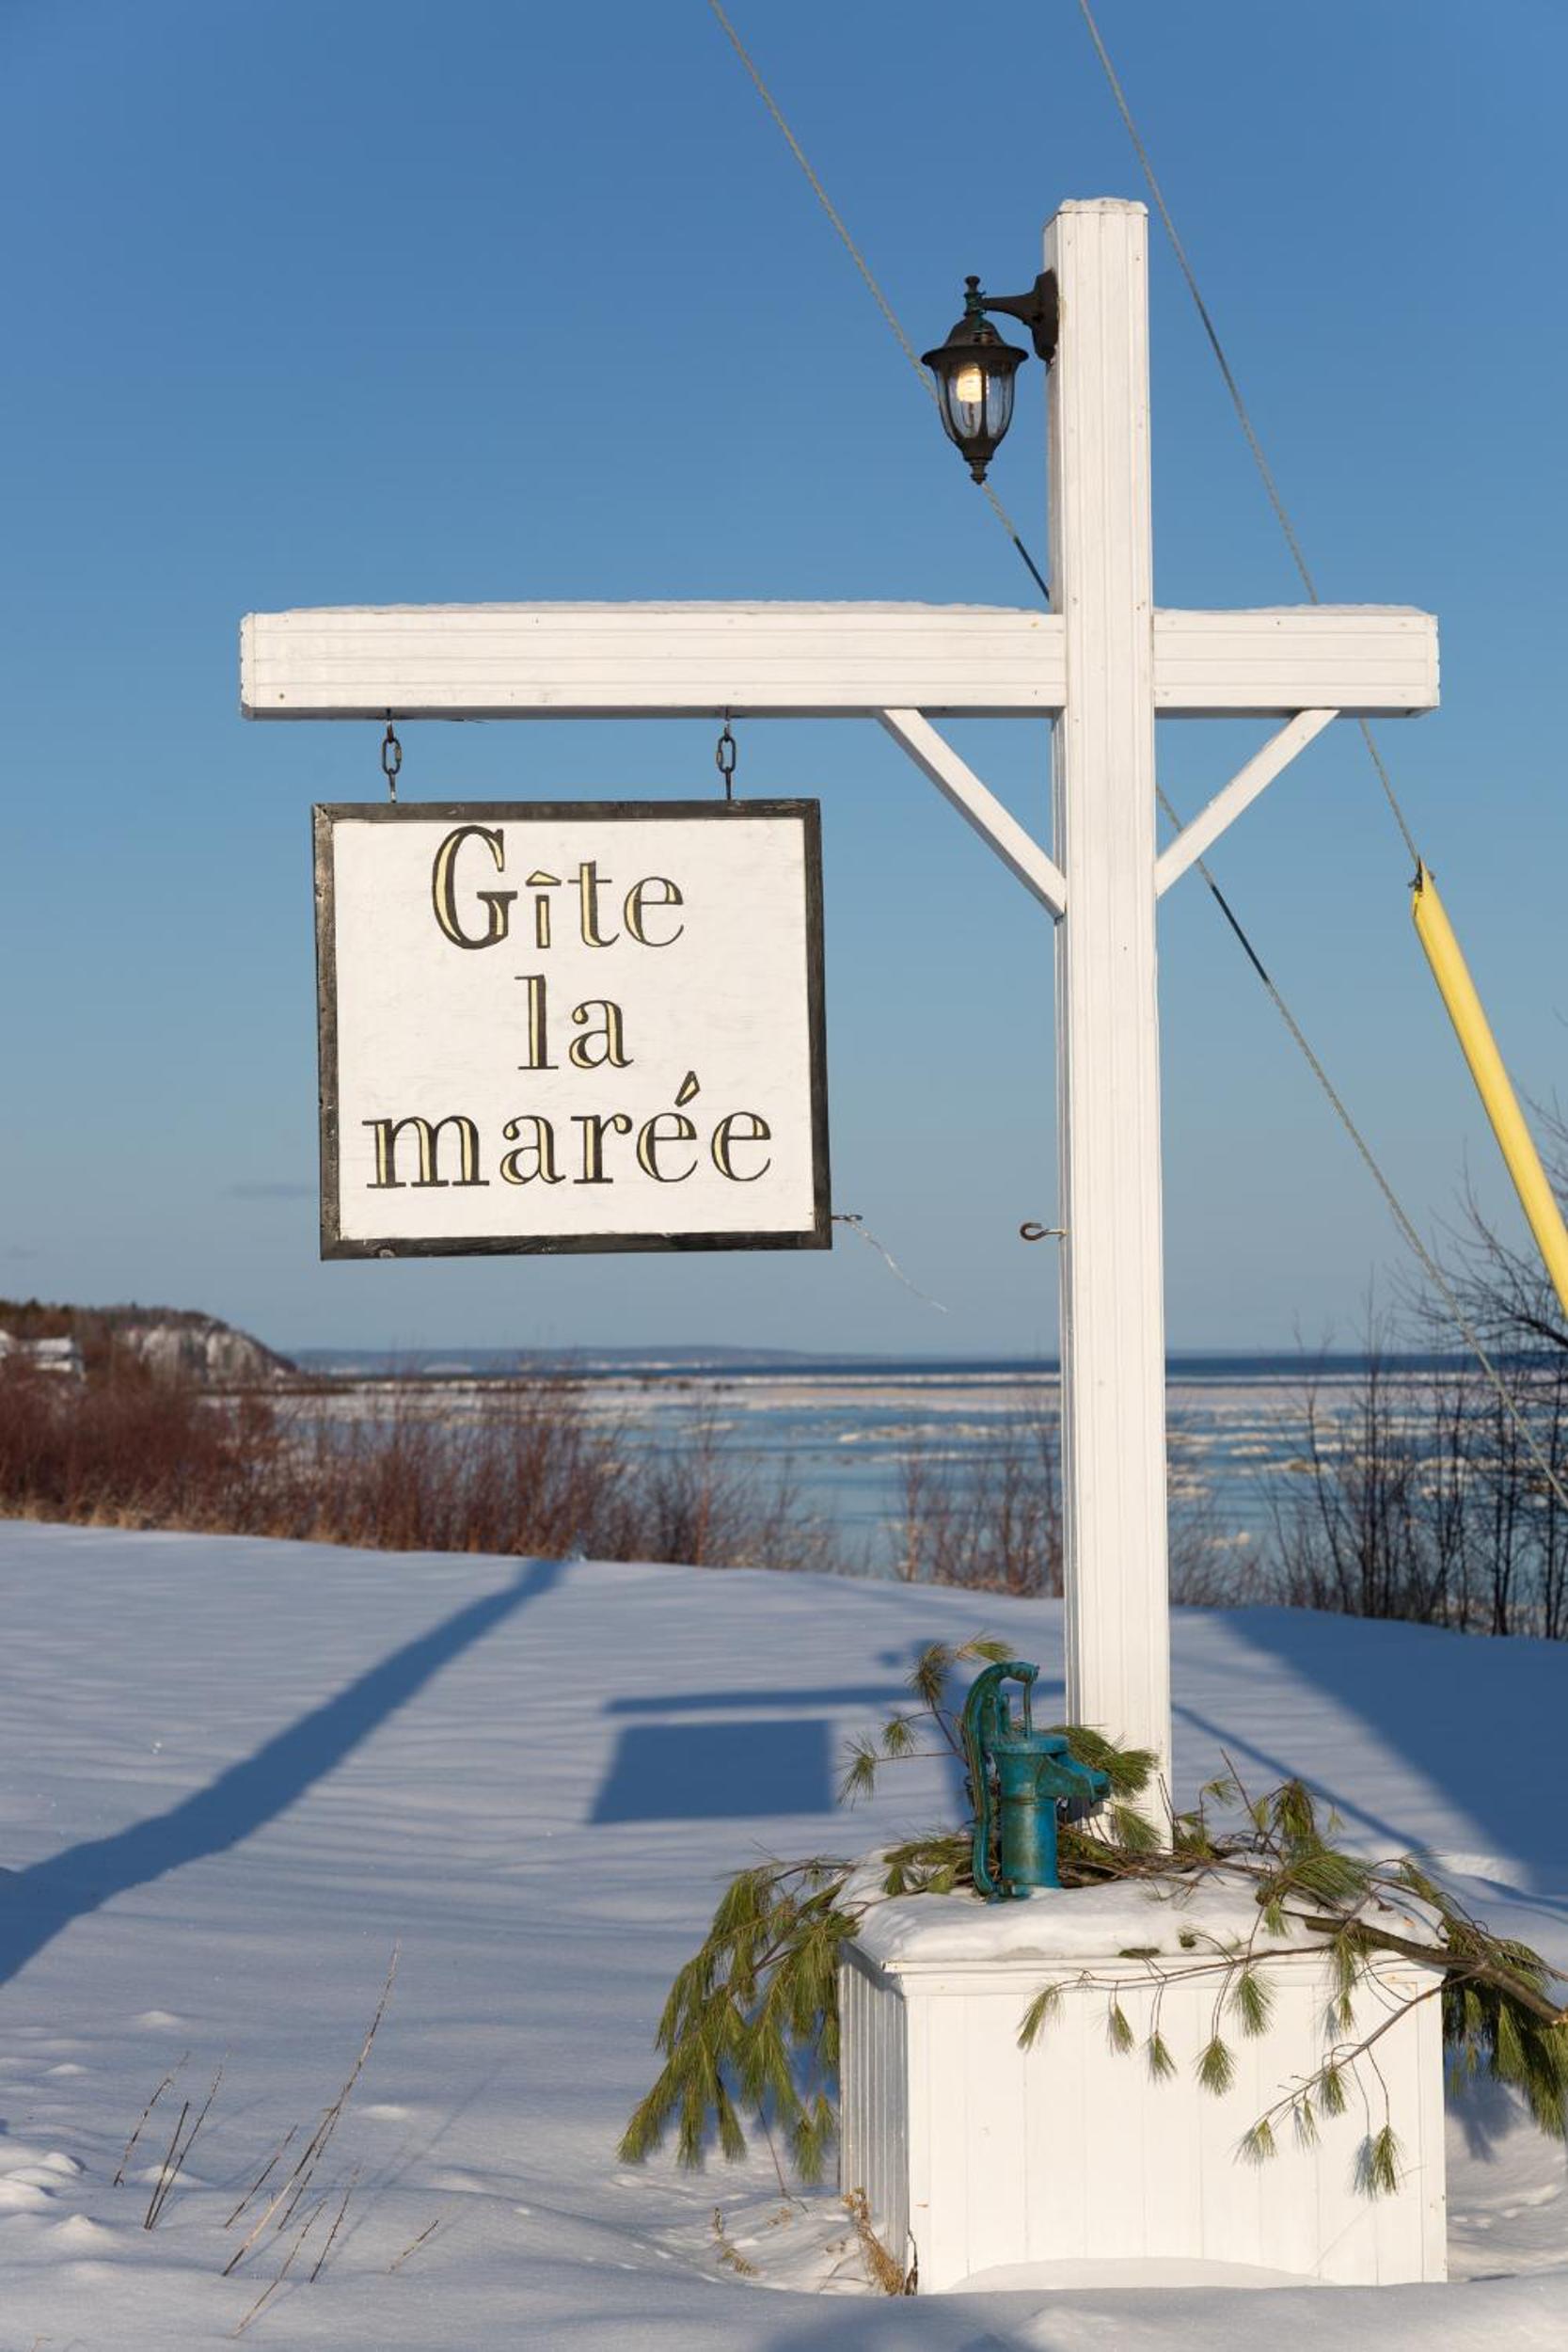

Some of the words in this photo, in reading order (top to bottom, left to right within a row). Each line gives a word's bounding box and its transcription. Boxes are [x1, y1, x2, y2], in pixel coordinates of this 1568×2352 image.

[431, 824, 685, 950] Gîte
[514, 974, 635, 1071] la
[361, 1070, 771, 1189] marée
